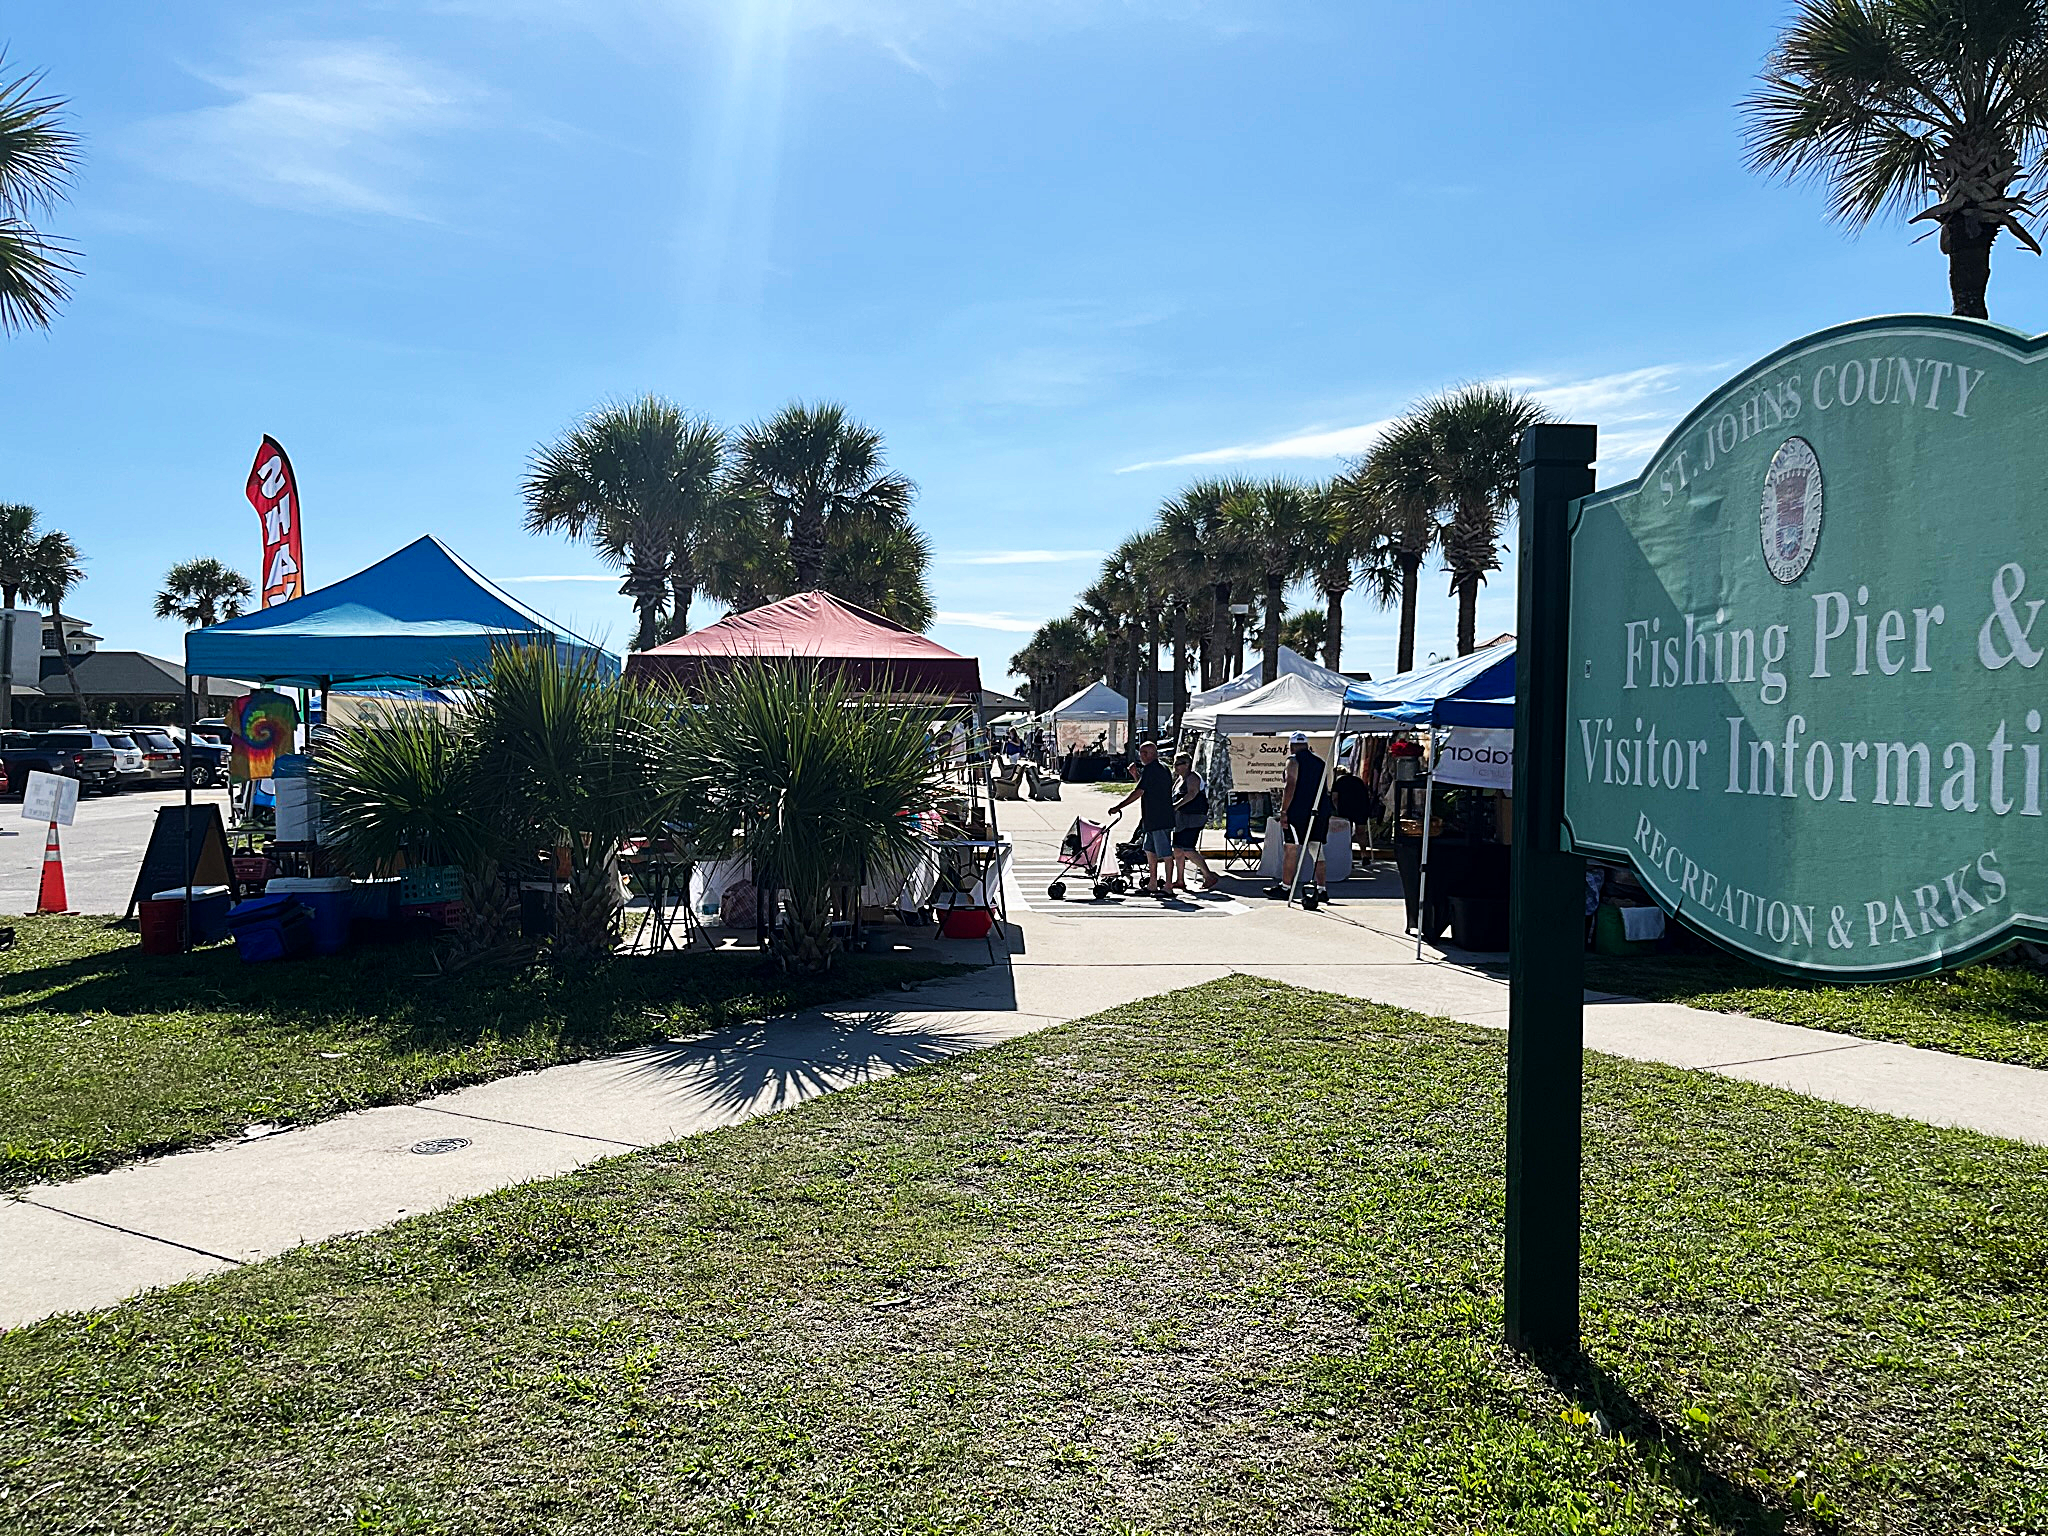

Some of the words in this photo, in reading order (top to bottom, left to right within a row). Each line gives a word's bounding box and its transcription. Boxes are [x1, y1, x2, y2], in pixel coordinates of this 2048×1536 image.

[1660, 451, 1699, 507] ST.
[1703, 374, 1802, 471] JOHNS
[1812, 356, 1985, 418] COUNTY
[1623, 607, 1789, 705] Fishing
[1808, 585, 1945, 678] Pier
[1978, 562, 2046, 670] &
[1578, 717, 1708, 790] Visitor
[1724, 709, 2043, 816] Informati
[1633, 810, 1815, 948] RECREATION
[1827, 905, 1854, 949] &
[1863, 849, 2007, 947] PARKS
